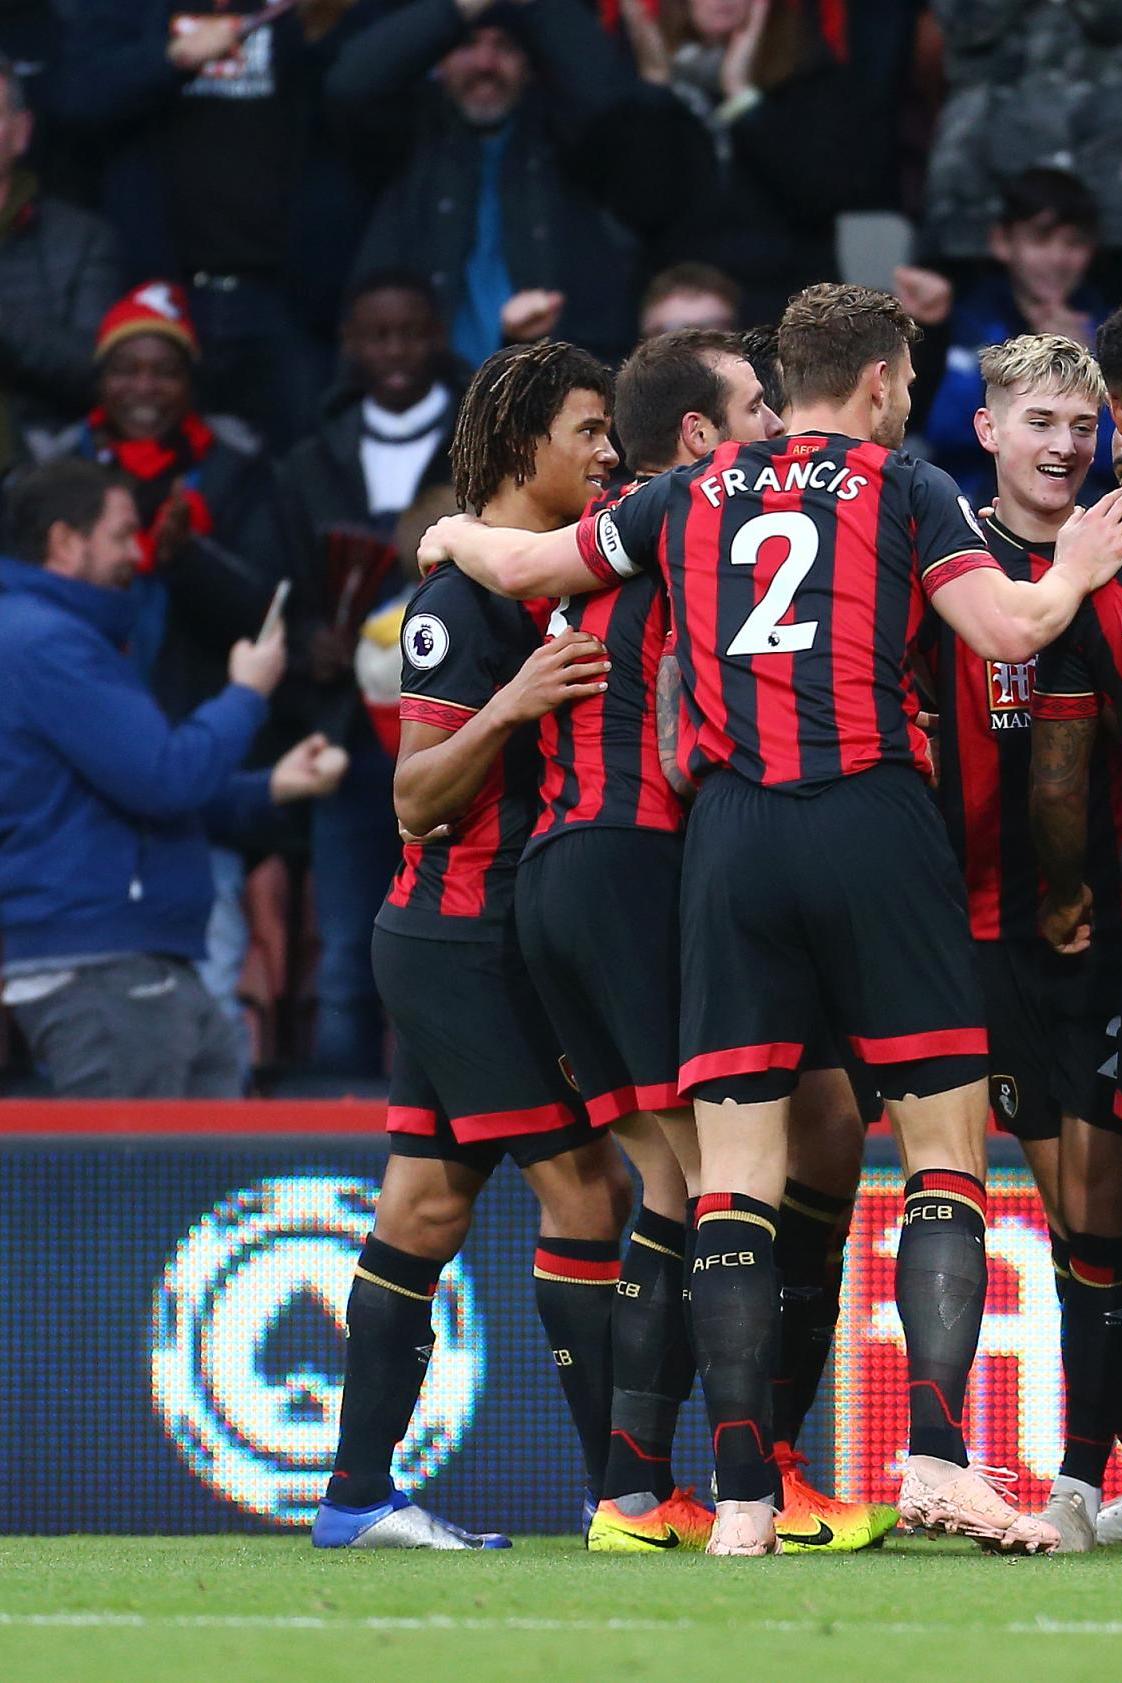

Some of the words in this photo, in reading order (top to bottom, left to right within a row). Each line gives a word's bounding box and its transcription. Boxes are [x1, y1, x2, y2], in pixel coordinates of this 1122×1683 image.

[700, 461, 868, 508] FRANCIS
[726, 511, 819, 656] 2
[692, 1251, 756, 1273] AFCB
